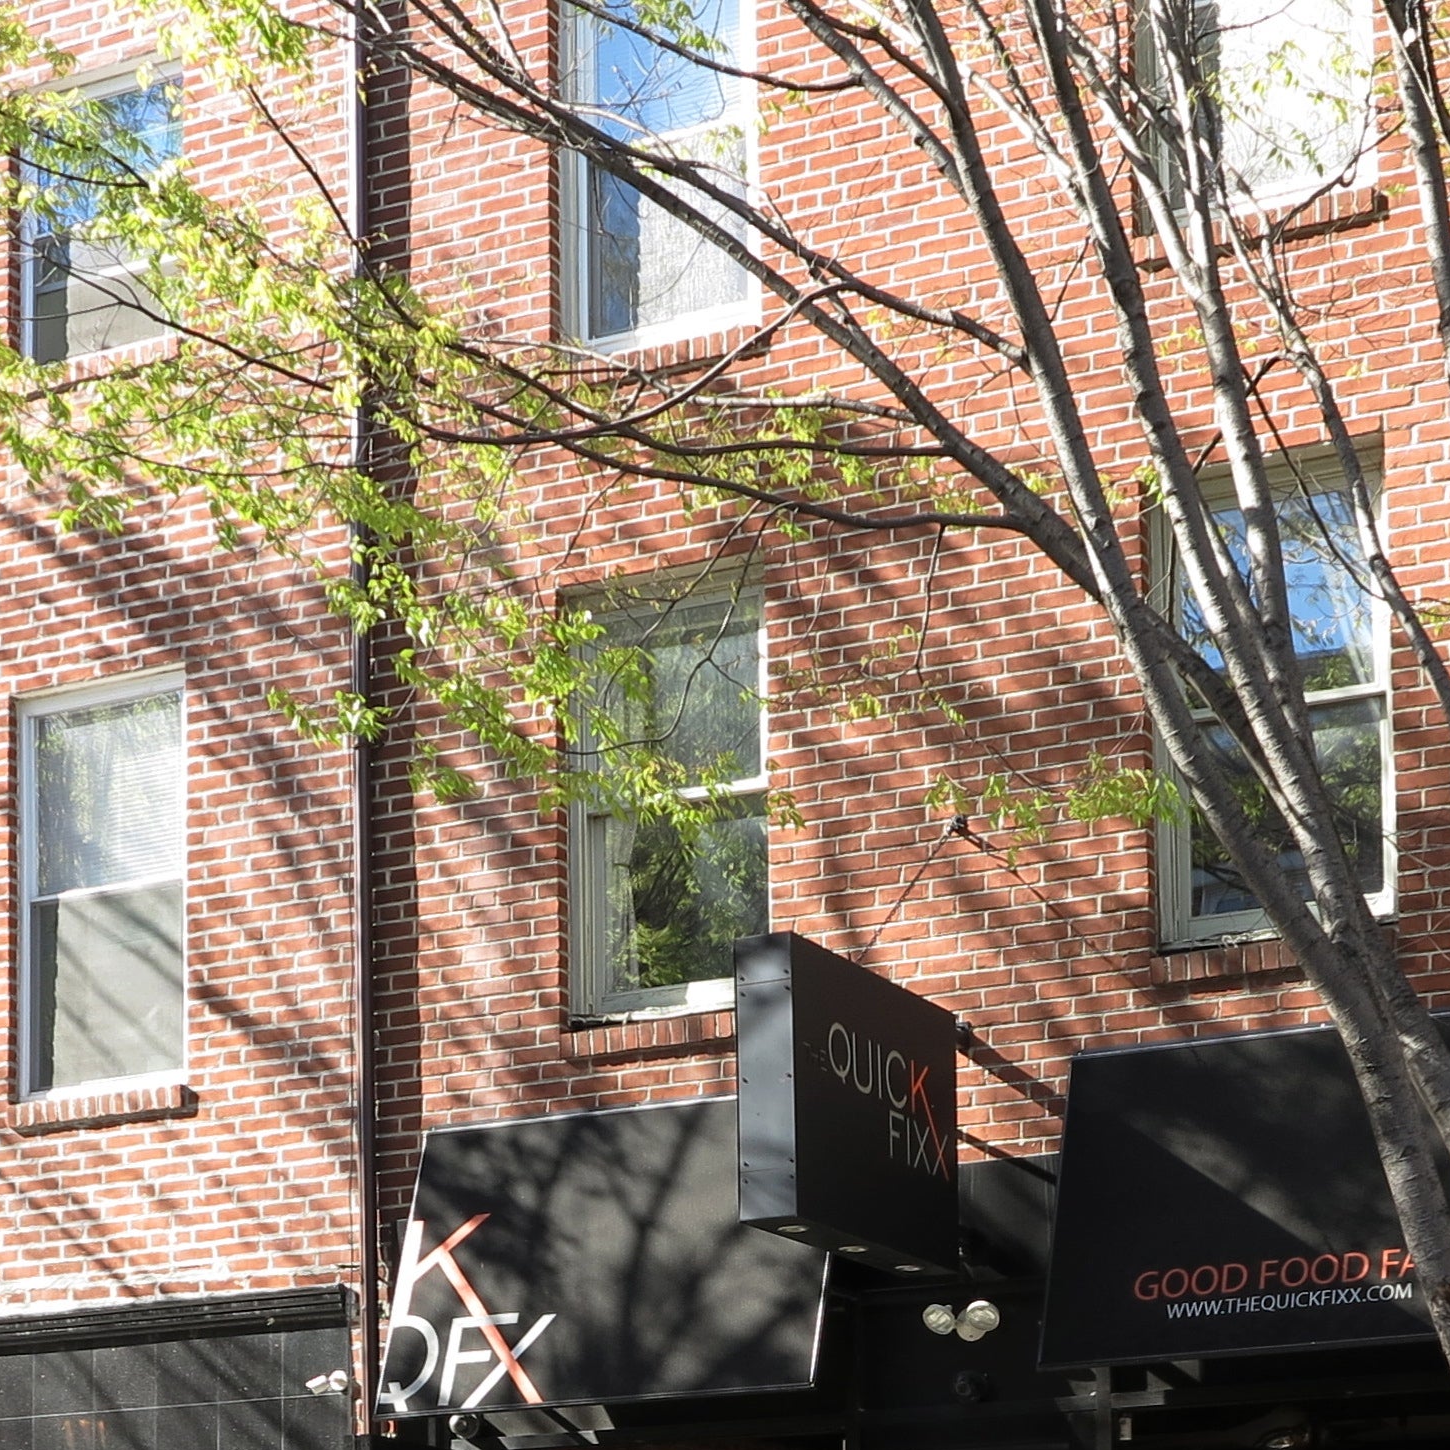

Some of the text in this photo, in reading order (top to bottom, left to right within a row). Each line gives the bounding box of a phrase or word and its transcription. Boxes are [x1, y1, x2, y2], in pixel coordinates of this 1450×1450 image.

[828, 1022, 929, 1114] QUICK
[889, 1109, 949, 1182] FIXX
[1133, 1262, 1249, 1301] GOOD
[1258, 1251, 1370, 1290] FOOD
[1166, 1282, 1413, 1320] WWW.THEQUICKFIXX.COM
